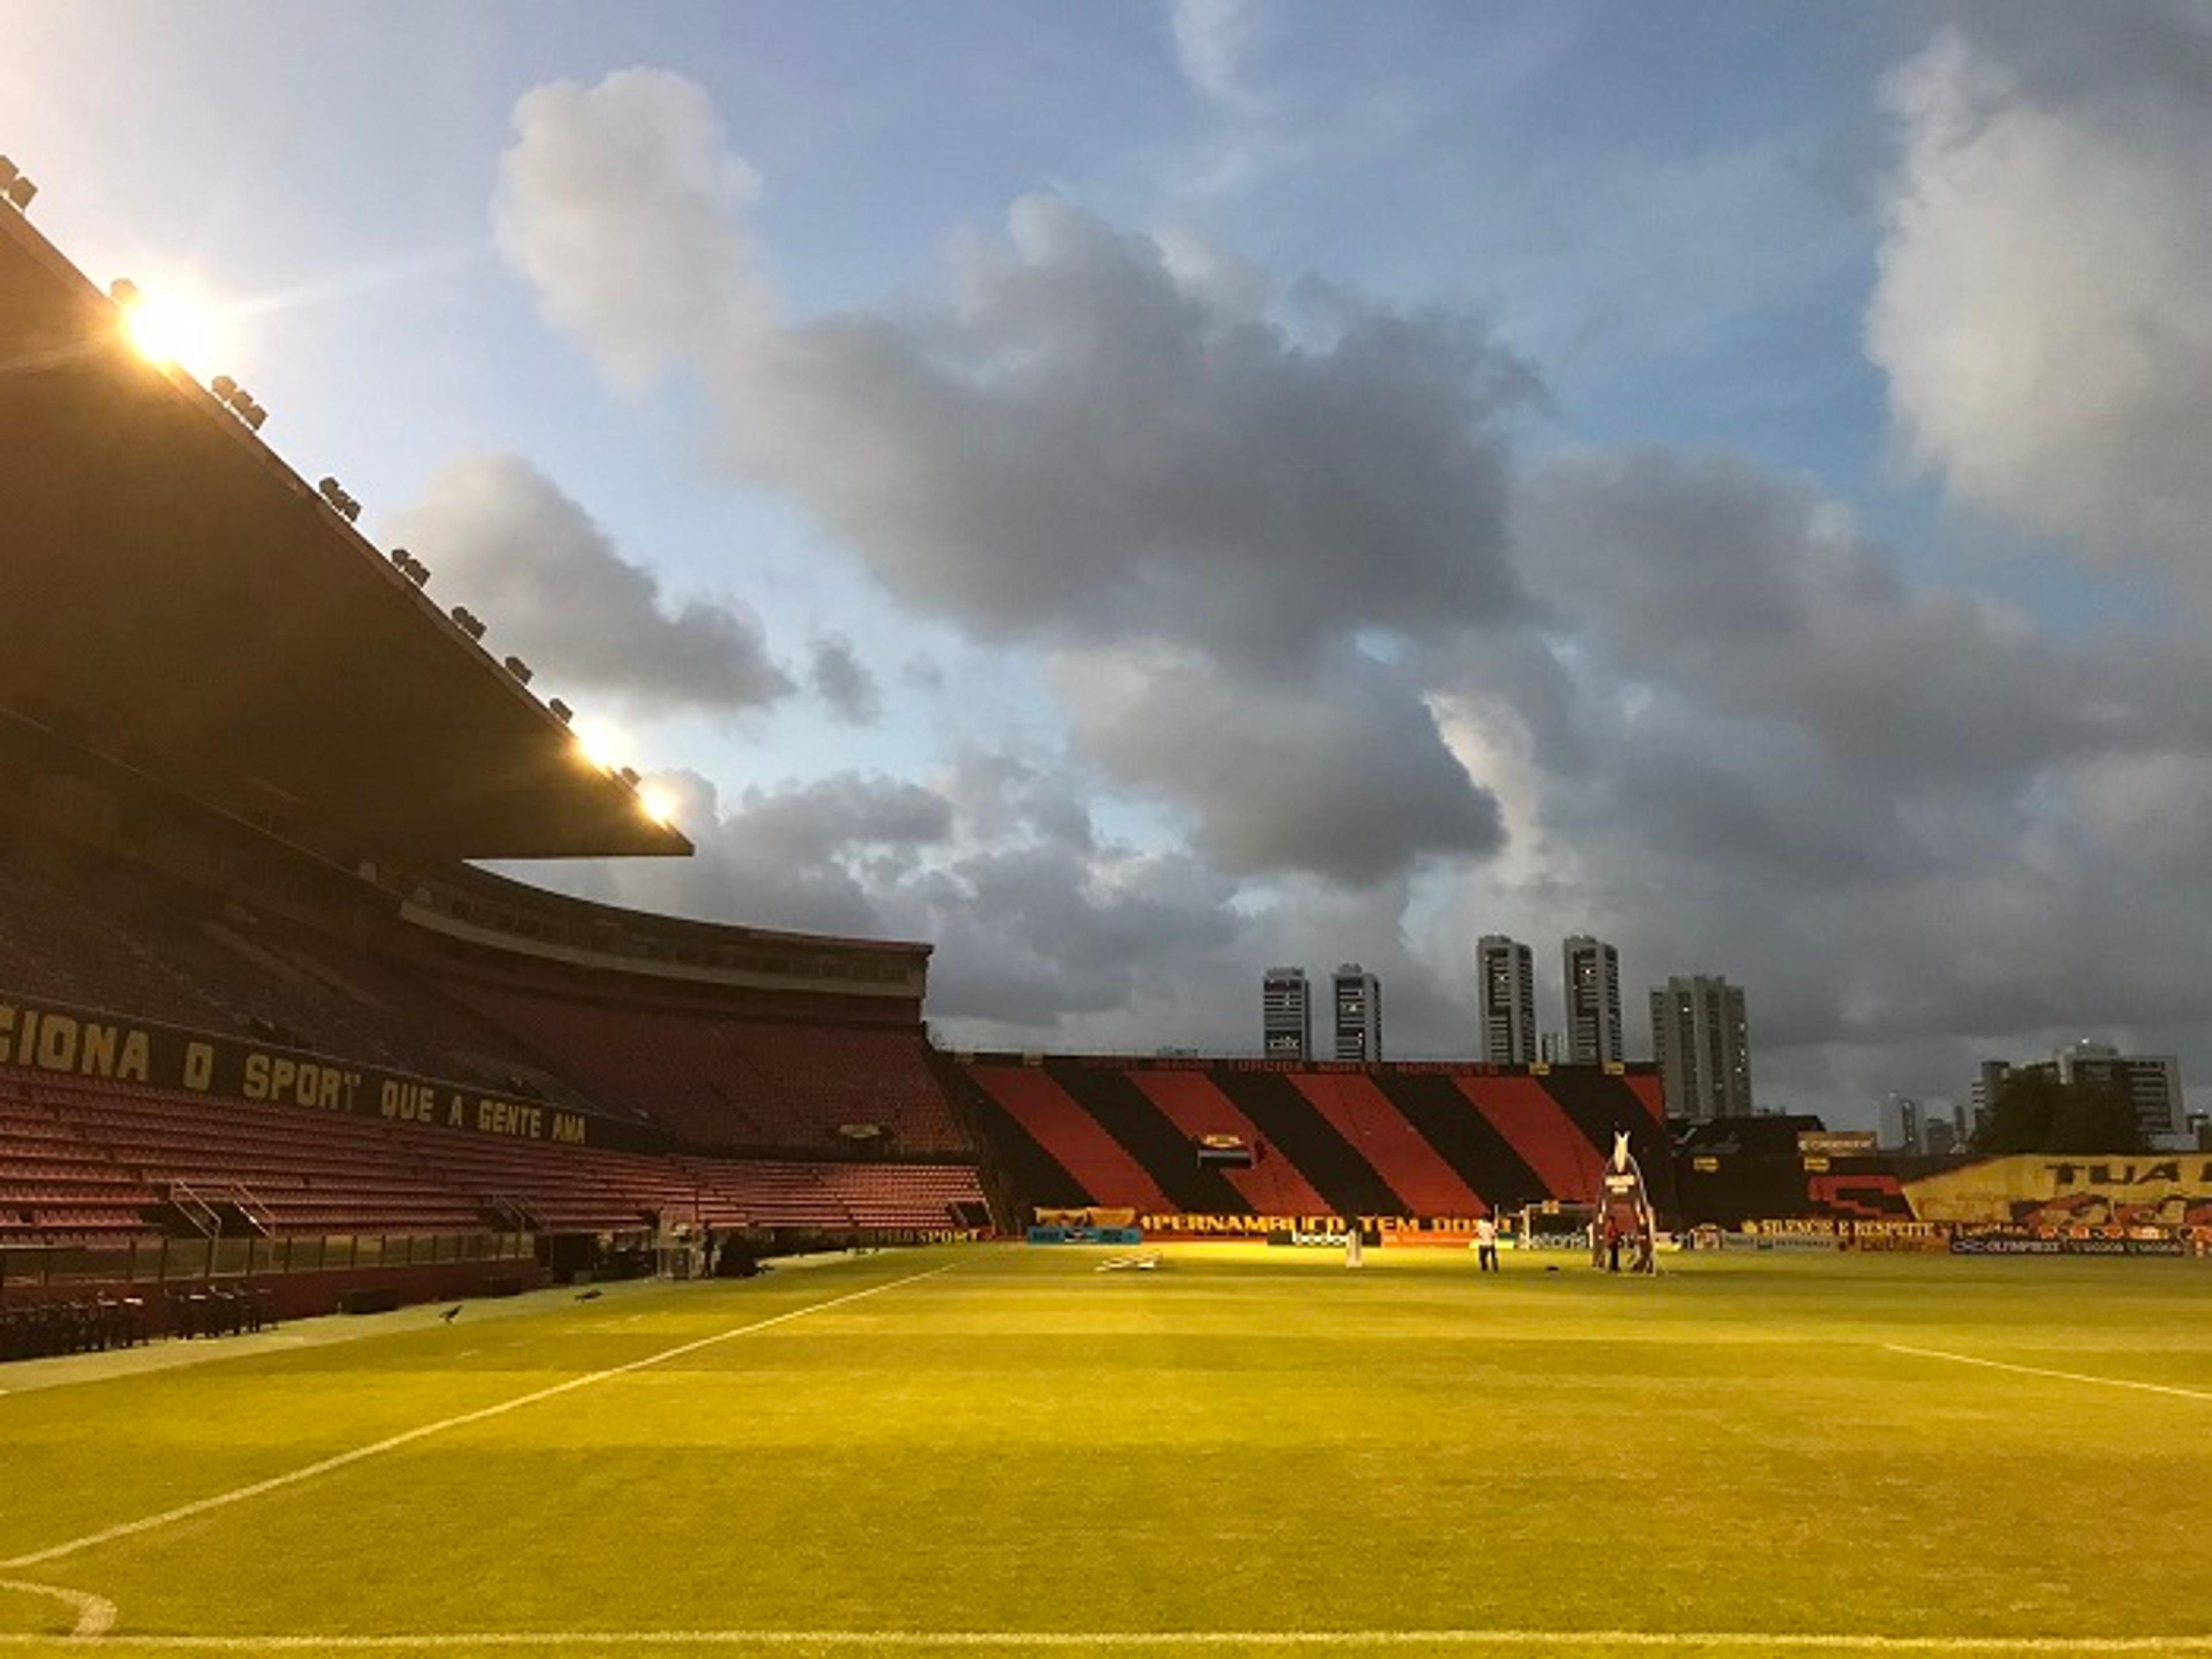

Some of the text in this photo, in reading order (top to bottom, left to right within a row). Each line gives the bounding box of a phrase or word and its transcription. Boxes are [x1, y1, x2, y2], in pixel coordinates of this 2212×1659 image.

[183, 1041, 213, 1090] O
[243, 1054, 361, 1113] SPORT
[381, 1080, 434, 1123] QUE
[448, 1095, 462, 1127] A
[478, 1099, 541, 1139] GENTE
[552, 1113, 586, 1145] AMA
[1357, 1214, 1419, 1233] TEM
[916, 1228, 981, 1243] SPORT
